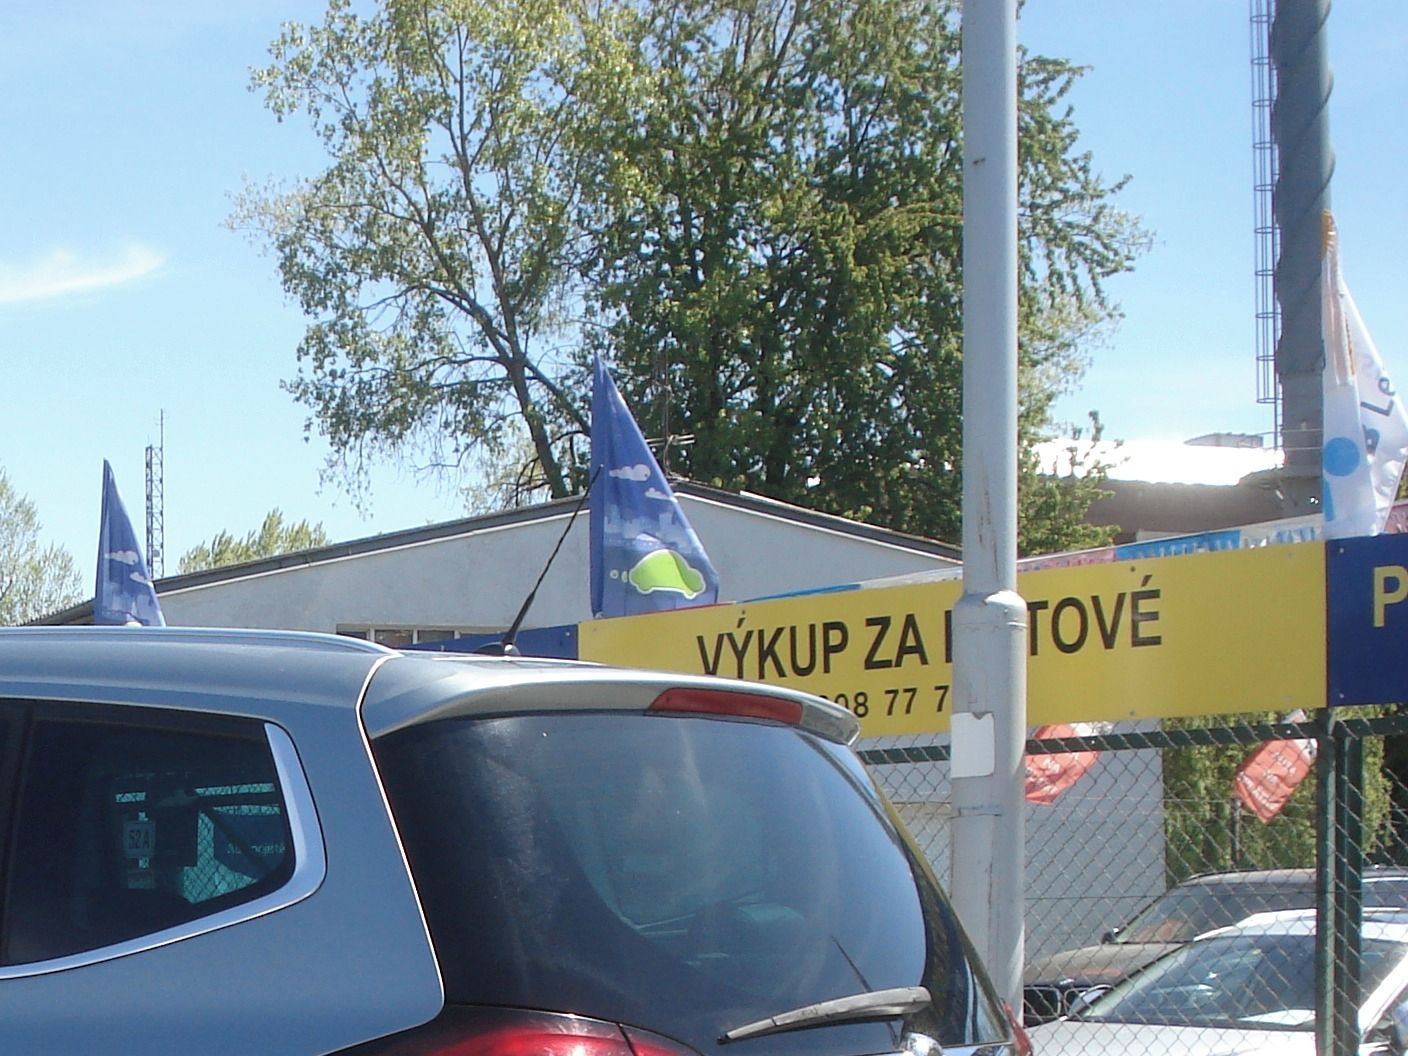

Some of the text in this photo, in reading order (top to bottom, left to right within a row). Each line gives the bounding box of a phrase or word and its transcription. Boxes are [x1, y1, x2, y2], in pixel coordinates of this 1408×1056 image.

[696, 616, 849, 681] VÝKUP
[864, 613, 929, 670] ZA
[884, 687, 917, 716] 77
